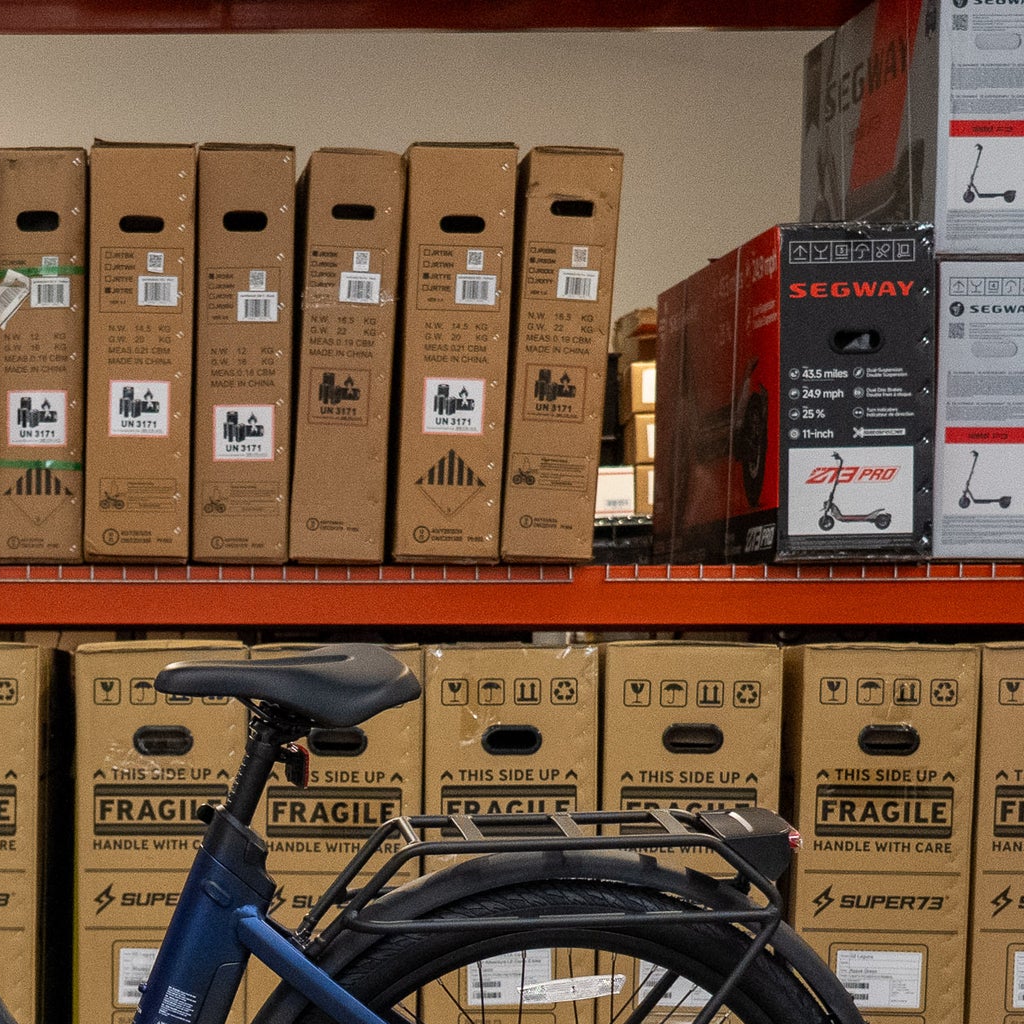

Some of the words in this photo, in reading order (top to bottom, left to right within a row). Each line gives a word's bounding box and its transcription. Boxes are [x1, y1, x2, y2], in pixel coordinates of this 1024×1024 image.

[789, 281, 914, 298] SEGWAY
[363, 317, 376, 325] KG
[364, 328, 376, 336] KG
[581, 326, 593, 334] KG
[158, 336, 171, 344] KG
[476, 334, 488, 342] KG
[552, 346, 561, 354] IN
[563, 347, 590, 355] CHINA
[145, 358, 172, 366] CHINA
[802, 369, 822, 378] 43.5
[824, 368, 848, 378] miles
[248, 380, 275, 388] CHINA
[802, 389, 822, 398] 24.9
[823, 388, 844, 400] mph
[320, 406, 334, 415] UN
[336, 407, 357, 416] 3171
[536, 404, 550, 412] UN
[551, 404, 572, 413] 3171
[802, 410, 814, 418] 25
[816, 409, 826, 418] %
[121, 420, 134, 428] UN
[136, 420, 157, 428] 3171
[435, 417, 449, 426] UN
[450, 418, 472, 426] 3171
[20, 430, 32, 438] UN
[34, 430, 56, 438] 3171
[802, 428, 834, 438] 11-inch
[241, 444, 262, 452] 3171
[860, 466, 898, 482] PRO
[111, 768, 146, 780] THIS
[150, 768, 185, 780] SIDE
[192, 768, 212, 780] UP
[326, 770, 360, 783] SIDE
[364, 770, 386, 784] UP
[459, 769, 494, 782] THIS
[499, 769, 534, 781] SIDE
[539, 768, 560, 781] UP
[639, 770, 674, 783] THIS
[680, 771, 714, 784] SIDE
[720, 772, 740, 784] UP
[834, 768, 870, 782] THIS
[876, 770, 912, 782] SIDE
[916, 770, 938, 782] UP
[100, 799, 222, 821] FRAGIL
[272, 802, 395, 824] FRAGILE
[820, 800, 947, 824] FRAGILE
[93, 840, 148, 850] HANDLE
[153, 840, 188, 850] WITH
[266, 842, 321, 853] HANDLE
[326, 843, 360, 854] WITH
[814, 840, 870, 852] HANDLE
[876, 842, 911, 853] WITH
[916, 842, 952, 854] CARE
[121, 892, 180, 906] SUPE
[840, 894, 944, 910] SUPER73
